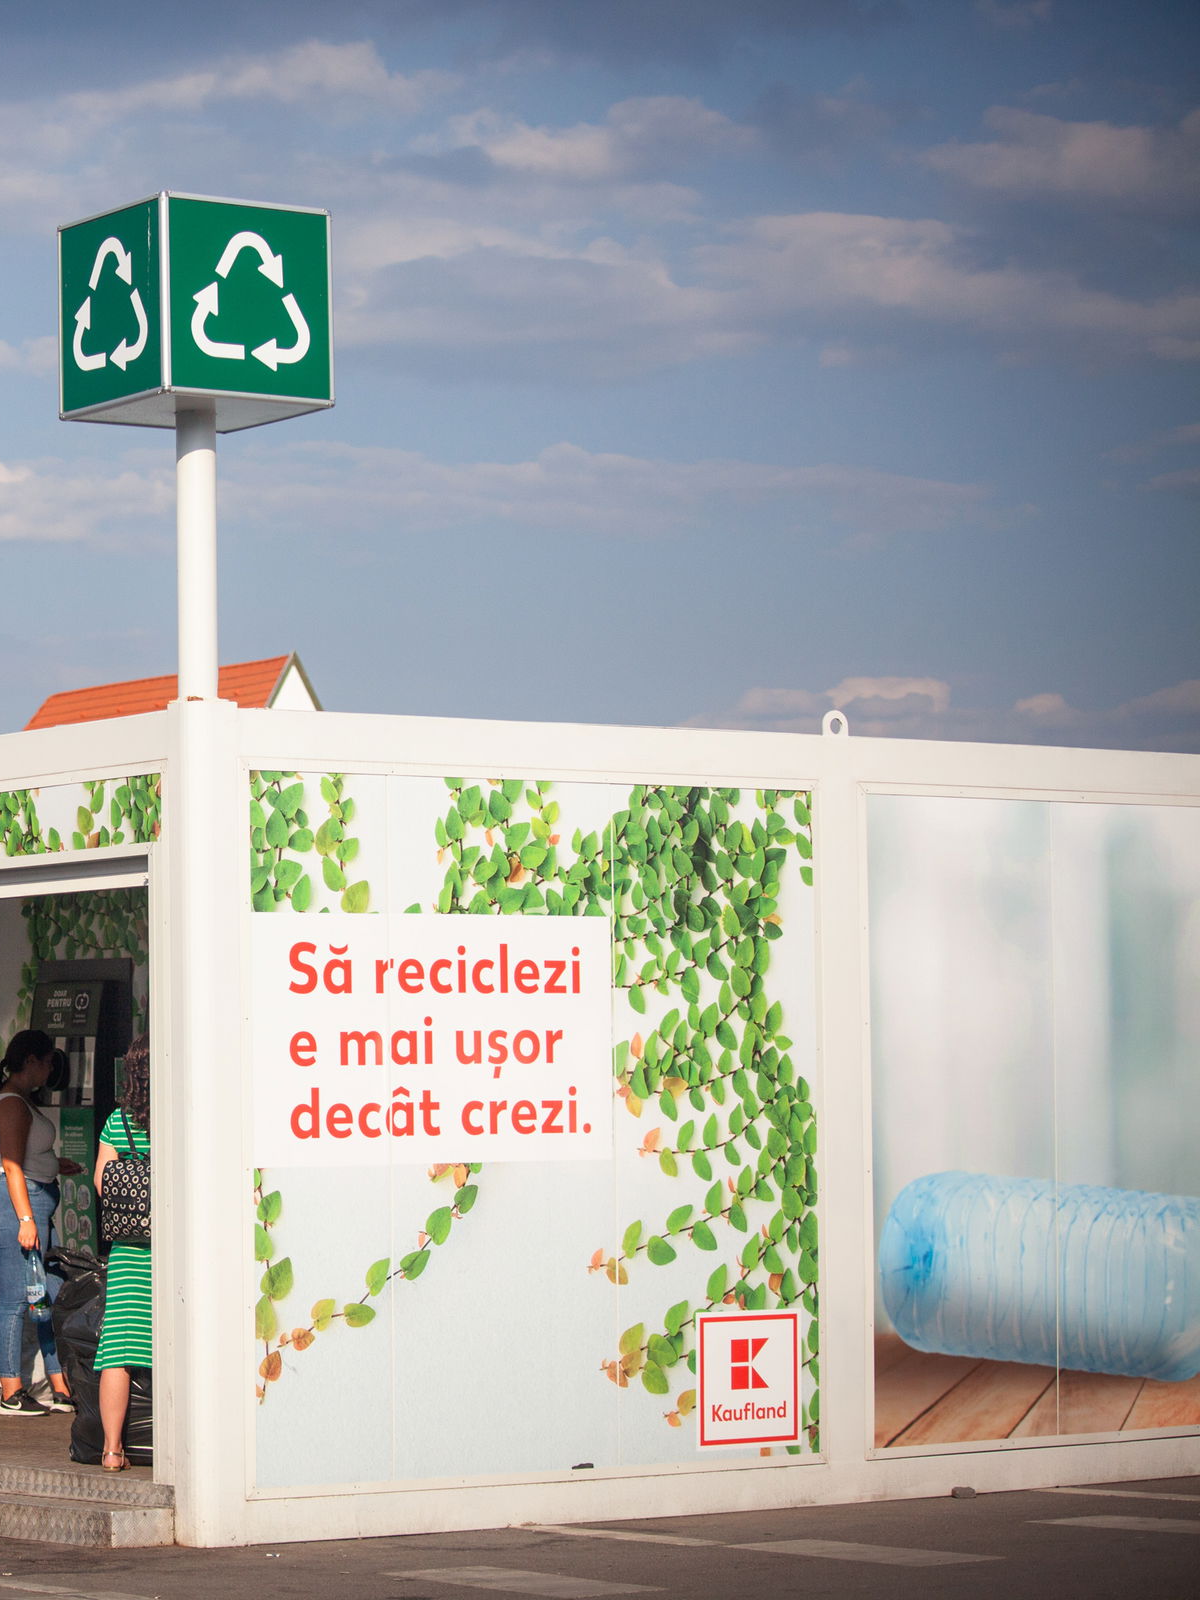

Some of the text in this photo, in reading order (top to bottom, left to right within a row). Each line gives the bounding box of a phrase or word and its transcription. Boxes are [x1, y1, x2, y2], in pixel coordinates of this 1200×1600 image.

[289, 941, 581, 995] Să reciclezi
[46, 998, 72, 1008] PENTRU
[290, 1016, 563, 1079] e mai ușor
[290, 1086, 592, 1139] decât crezi.
[712, 1400, 787, 1423] Kaufland
